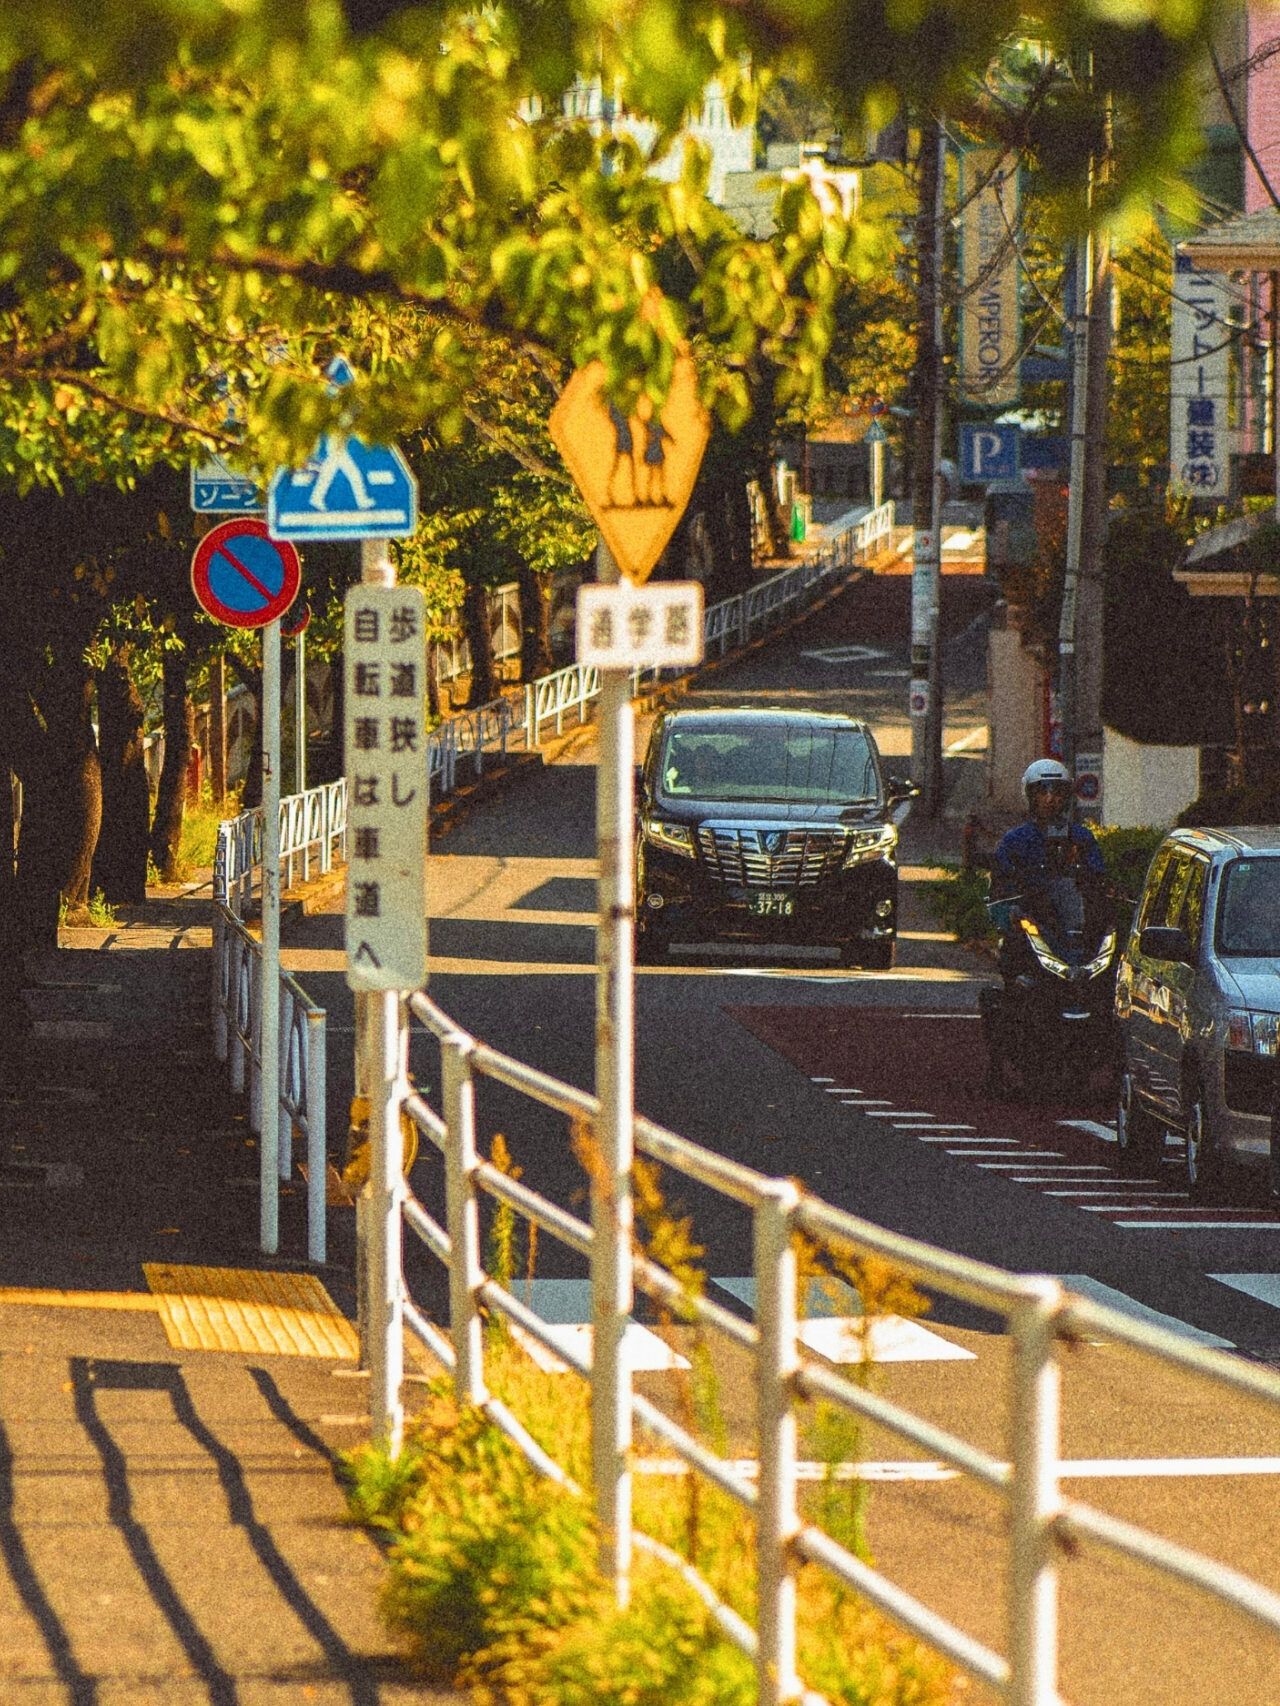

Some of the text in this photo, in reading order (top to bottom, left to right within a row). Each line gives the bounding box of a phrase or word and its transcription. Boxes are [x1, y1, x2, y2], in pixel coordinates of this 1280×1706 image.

[973, 430, 1002, 474] P
[388, 606, 418, 808] 歩道狭し
[352, 607, 383, 970] 自転車は車道へ
[757, 901, 792, 915] 37-18
